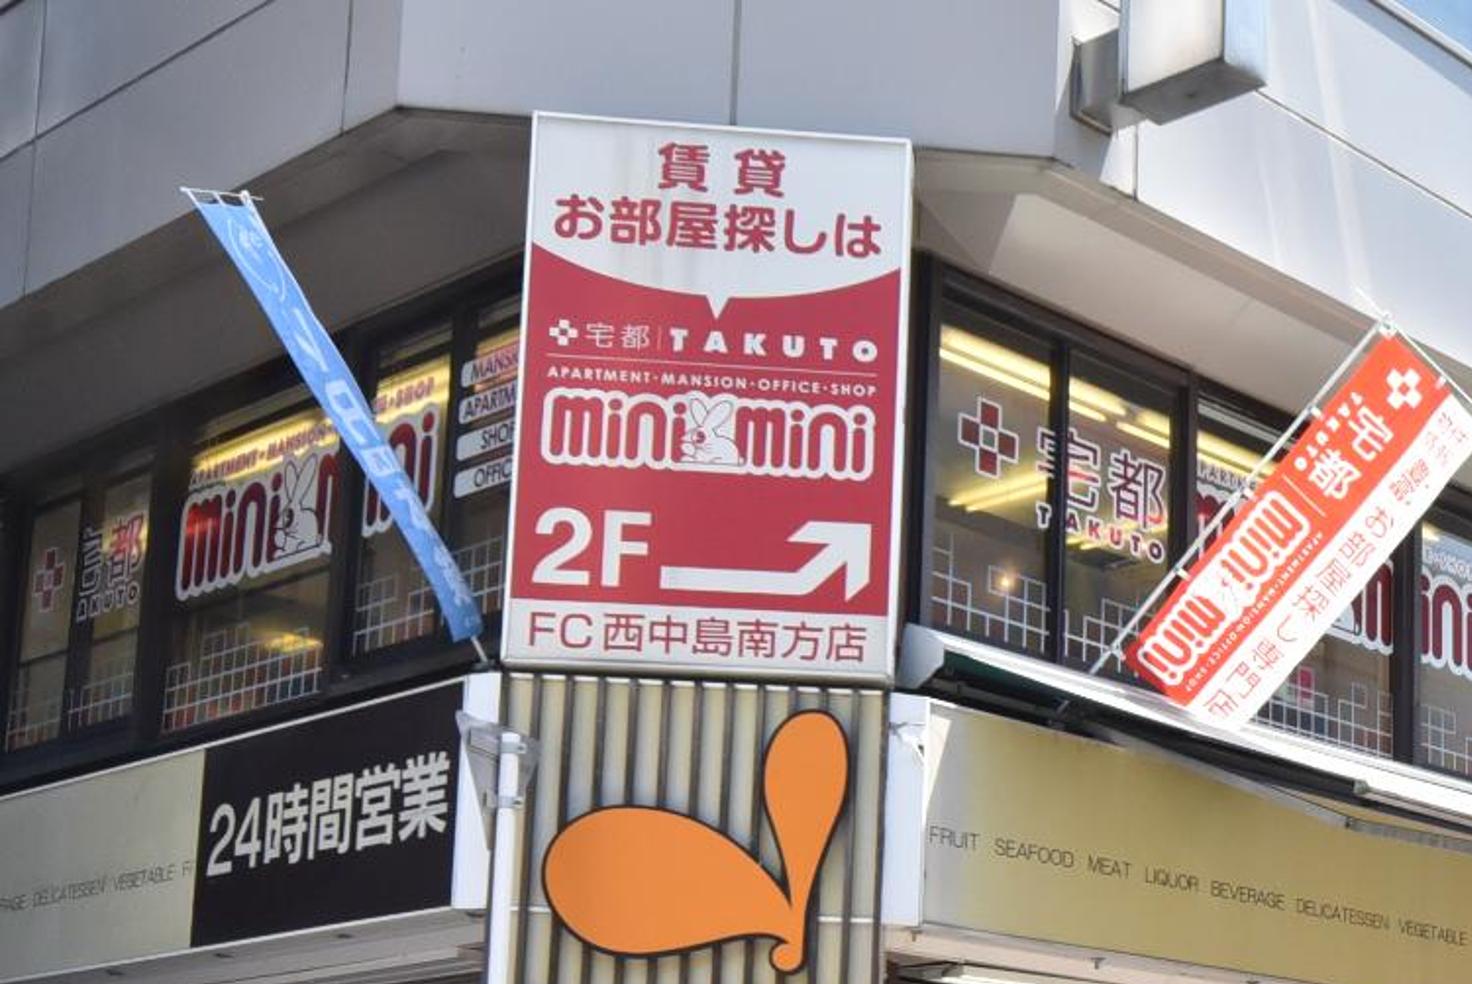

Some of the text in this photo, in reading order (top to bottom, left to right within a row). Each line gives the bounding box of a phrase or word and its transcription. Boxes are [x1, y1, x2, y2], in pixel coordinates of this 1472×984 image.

[657, 141, 786, 198] 賃貸
[553, 193, 882, 259] お部屋探しは
[585, 322, 879, 363] 宅都 TAKUTO
[543, 389, 874, 479] mini mini
[1035, 426, 1169, 528] 宅都
[1306, 405, 1395, 502] 宅都
[177, 471, 284, 598] mini
[530, 506, 653, 589] 2F
[1036, 503, 1165, 564] TAKUTO
[1220, 488, 1312, 592] mini
[1136, 593, 1226, 686] mini
[206, 750, 451, 878] 24時間営業
[929, 824, 981, 851] FRUIT
[994, 837, 1075, 870] SEAFOOD
[1087, 853, 1133, 880] MEAT
[1145, 865, 1200, 893] LIQUOR
[1210, 879, 1286, 912] BEVERAGE
[1296, 895, 1390, 931] DELICATESSEN
[1399, 917, 1469, 948] VEGETABLE
